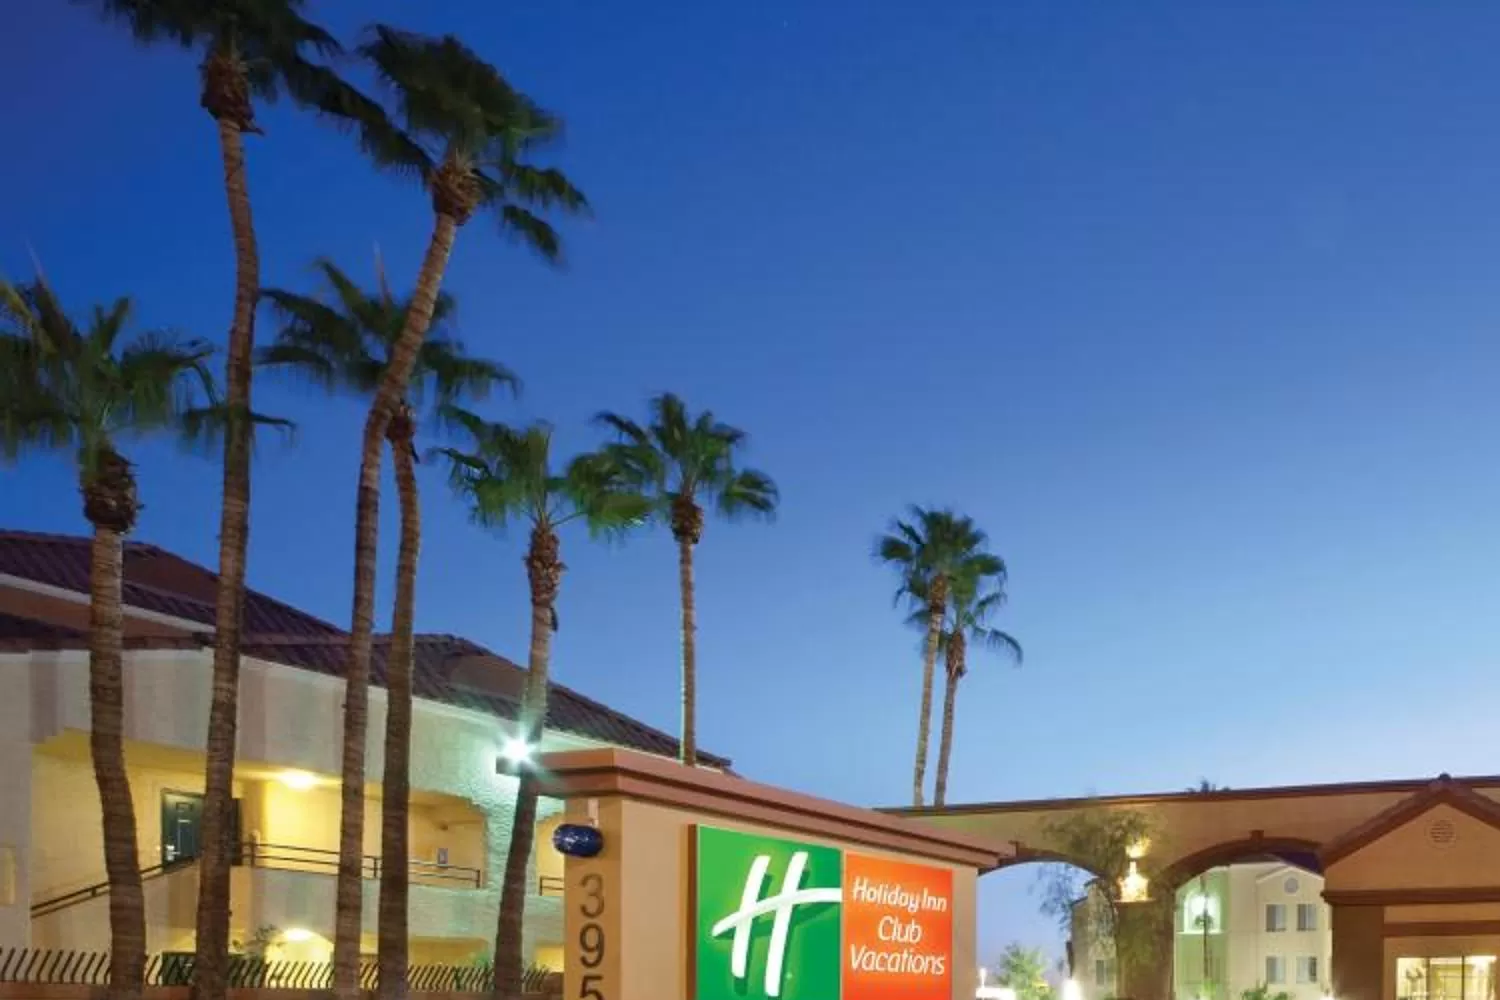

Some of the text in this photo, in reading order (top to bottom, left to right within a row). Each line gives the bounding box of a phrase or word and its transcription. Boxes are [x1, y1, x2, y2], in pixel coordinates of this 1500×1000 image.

[853, 876, 947, 912] Holiday Inn
[877, 916, 922, 944] Club
[850, 944, 946, 975] Vacations
